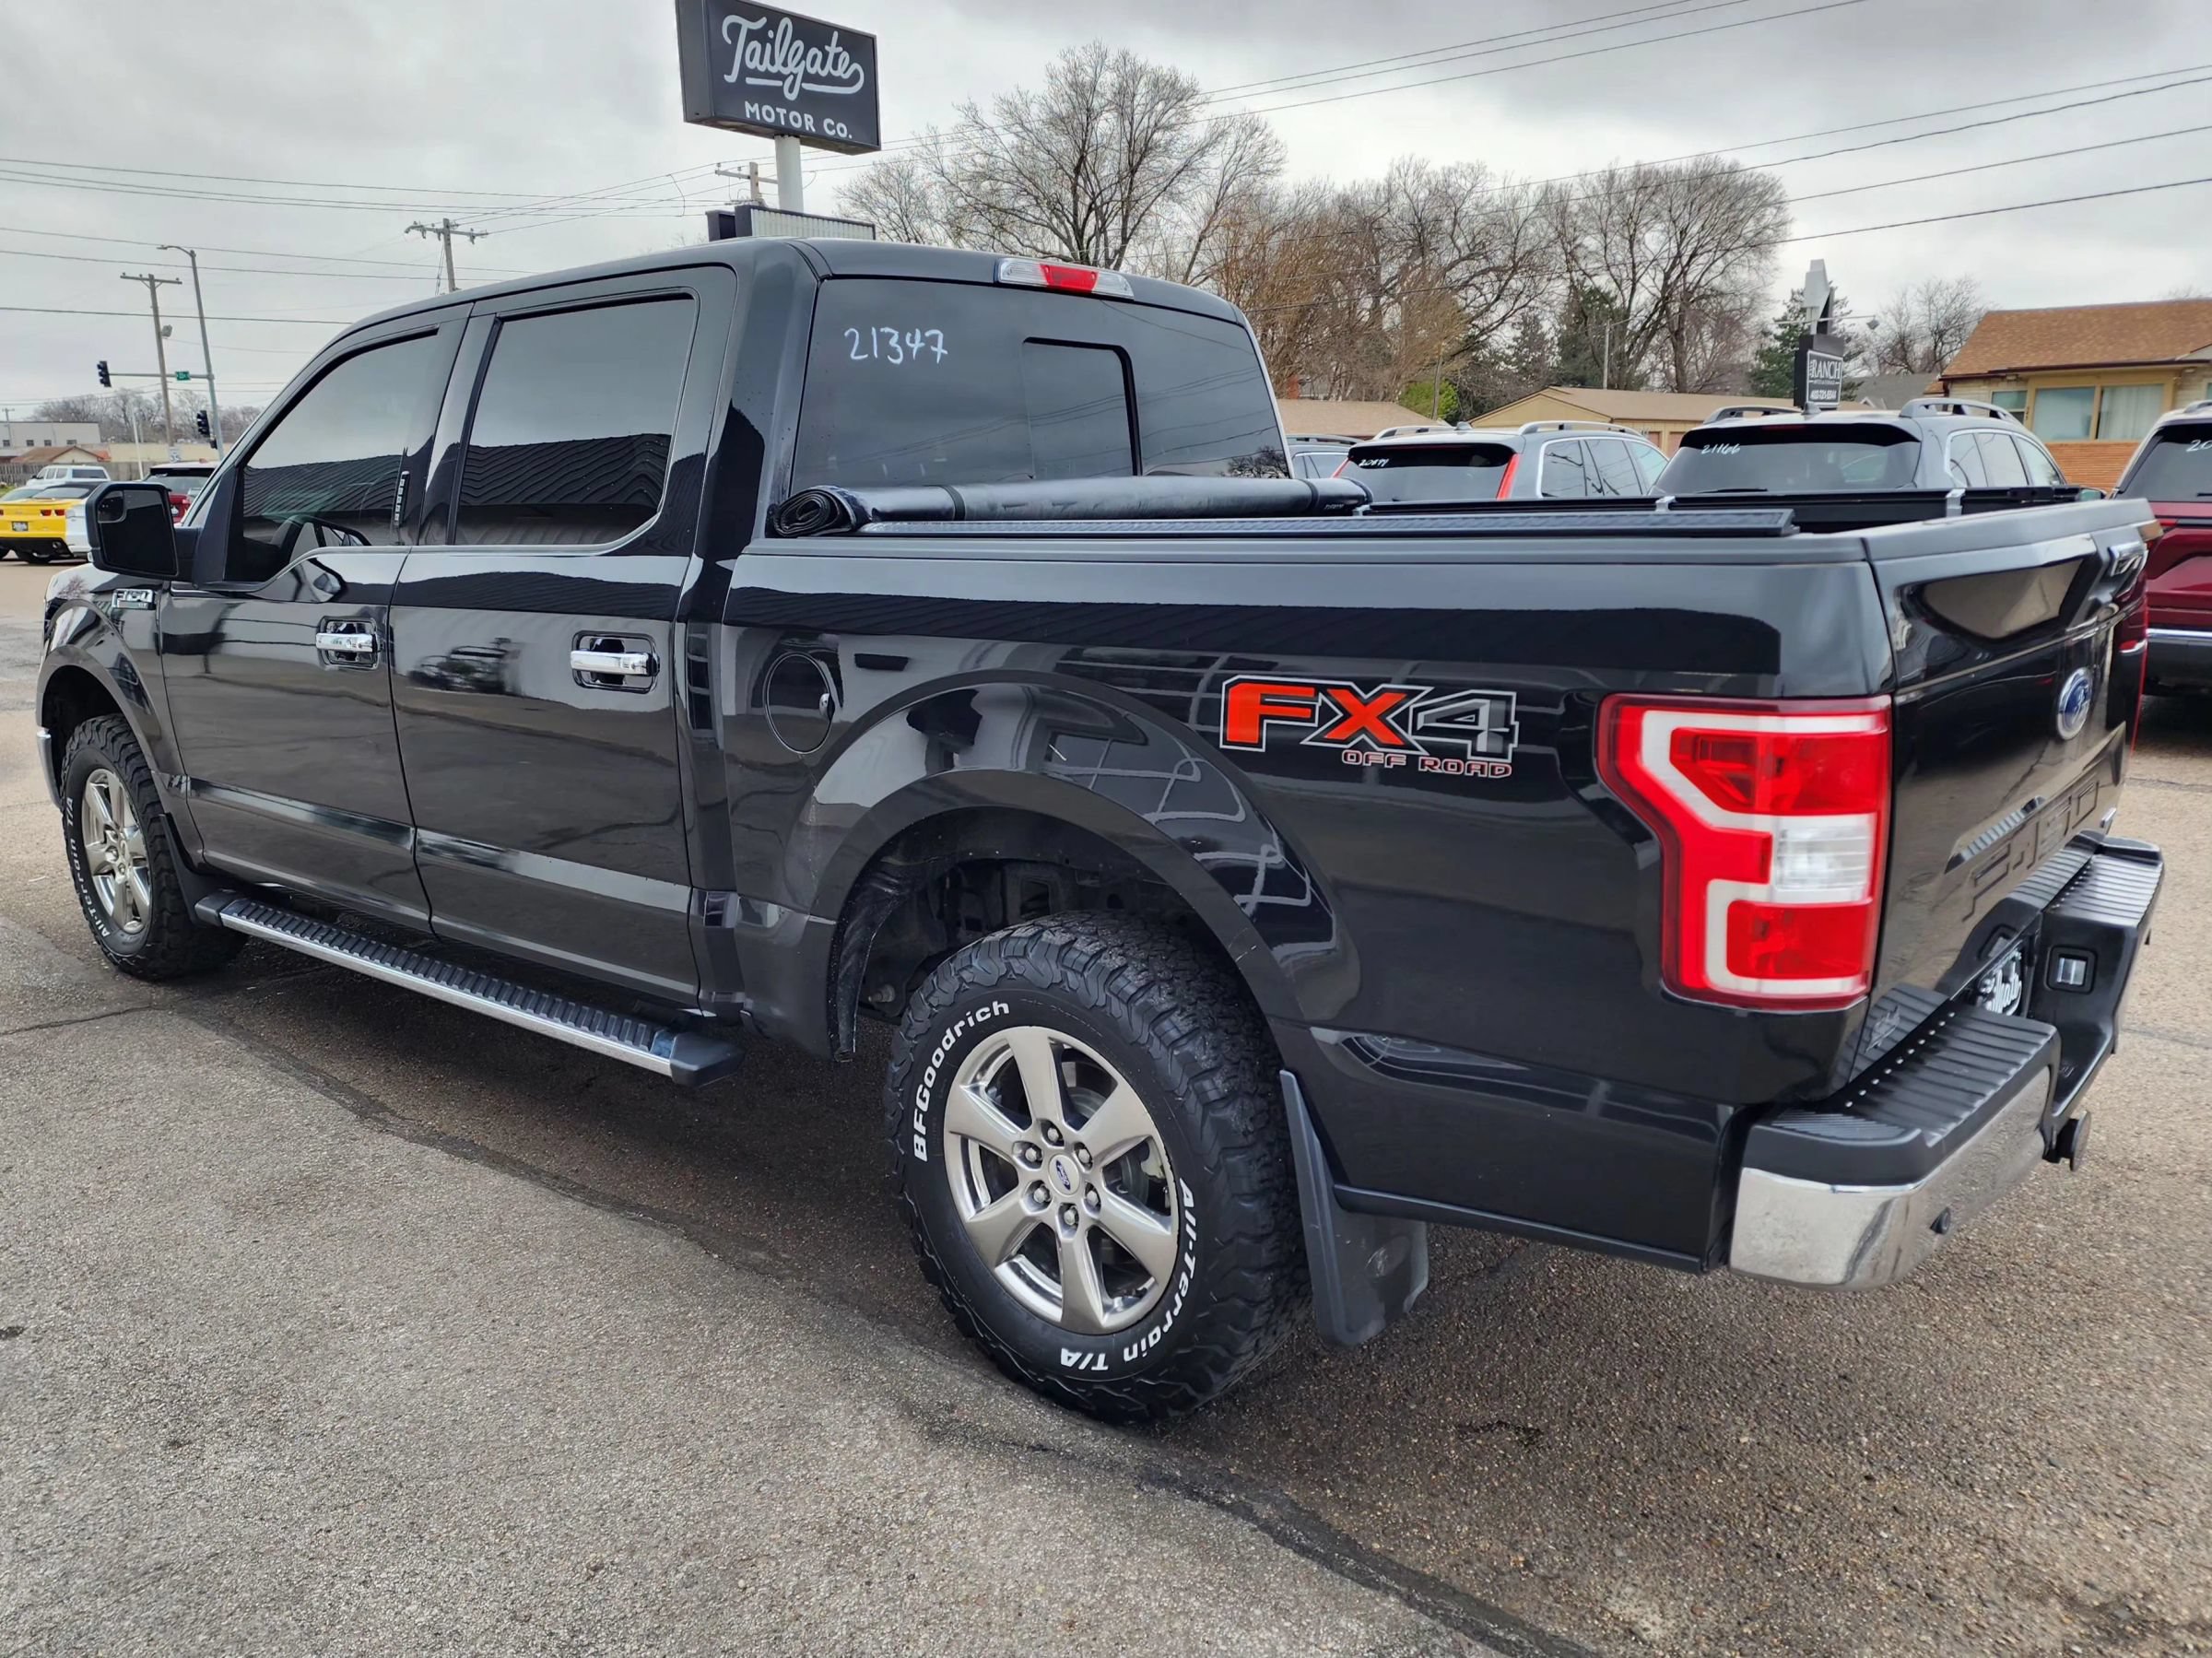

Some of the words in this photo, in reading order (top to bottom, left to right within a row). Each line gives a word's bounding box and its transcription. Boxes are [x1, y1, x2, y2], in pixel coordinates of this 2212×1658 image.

[722, 15, 865, 100] Tailgate
[745, 100, 816, 133] MOTOR
[823, 118, 853, 139] CO.
[843, 326, 948, 365] 21347
[1811, 359, 1841, 379] RANCH
[1701, 443, 1741, 454] 21166
[1220, 675, 1519, 764] FX4
[1342, 750, 1407, 769] OFF
[1418, 757, 1512, 779] ROAD
[70, 839, 111, 937] All-Terrain
[913, 1001, 1010, 1162] BFGoodrich
[1123, 1178, 1197, 1362] All-Terrain
[1060, 1347, 1109, 1371] T/A
